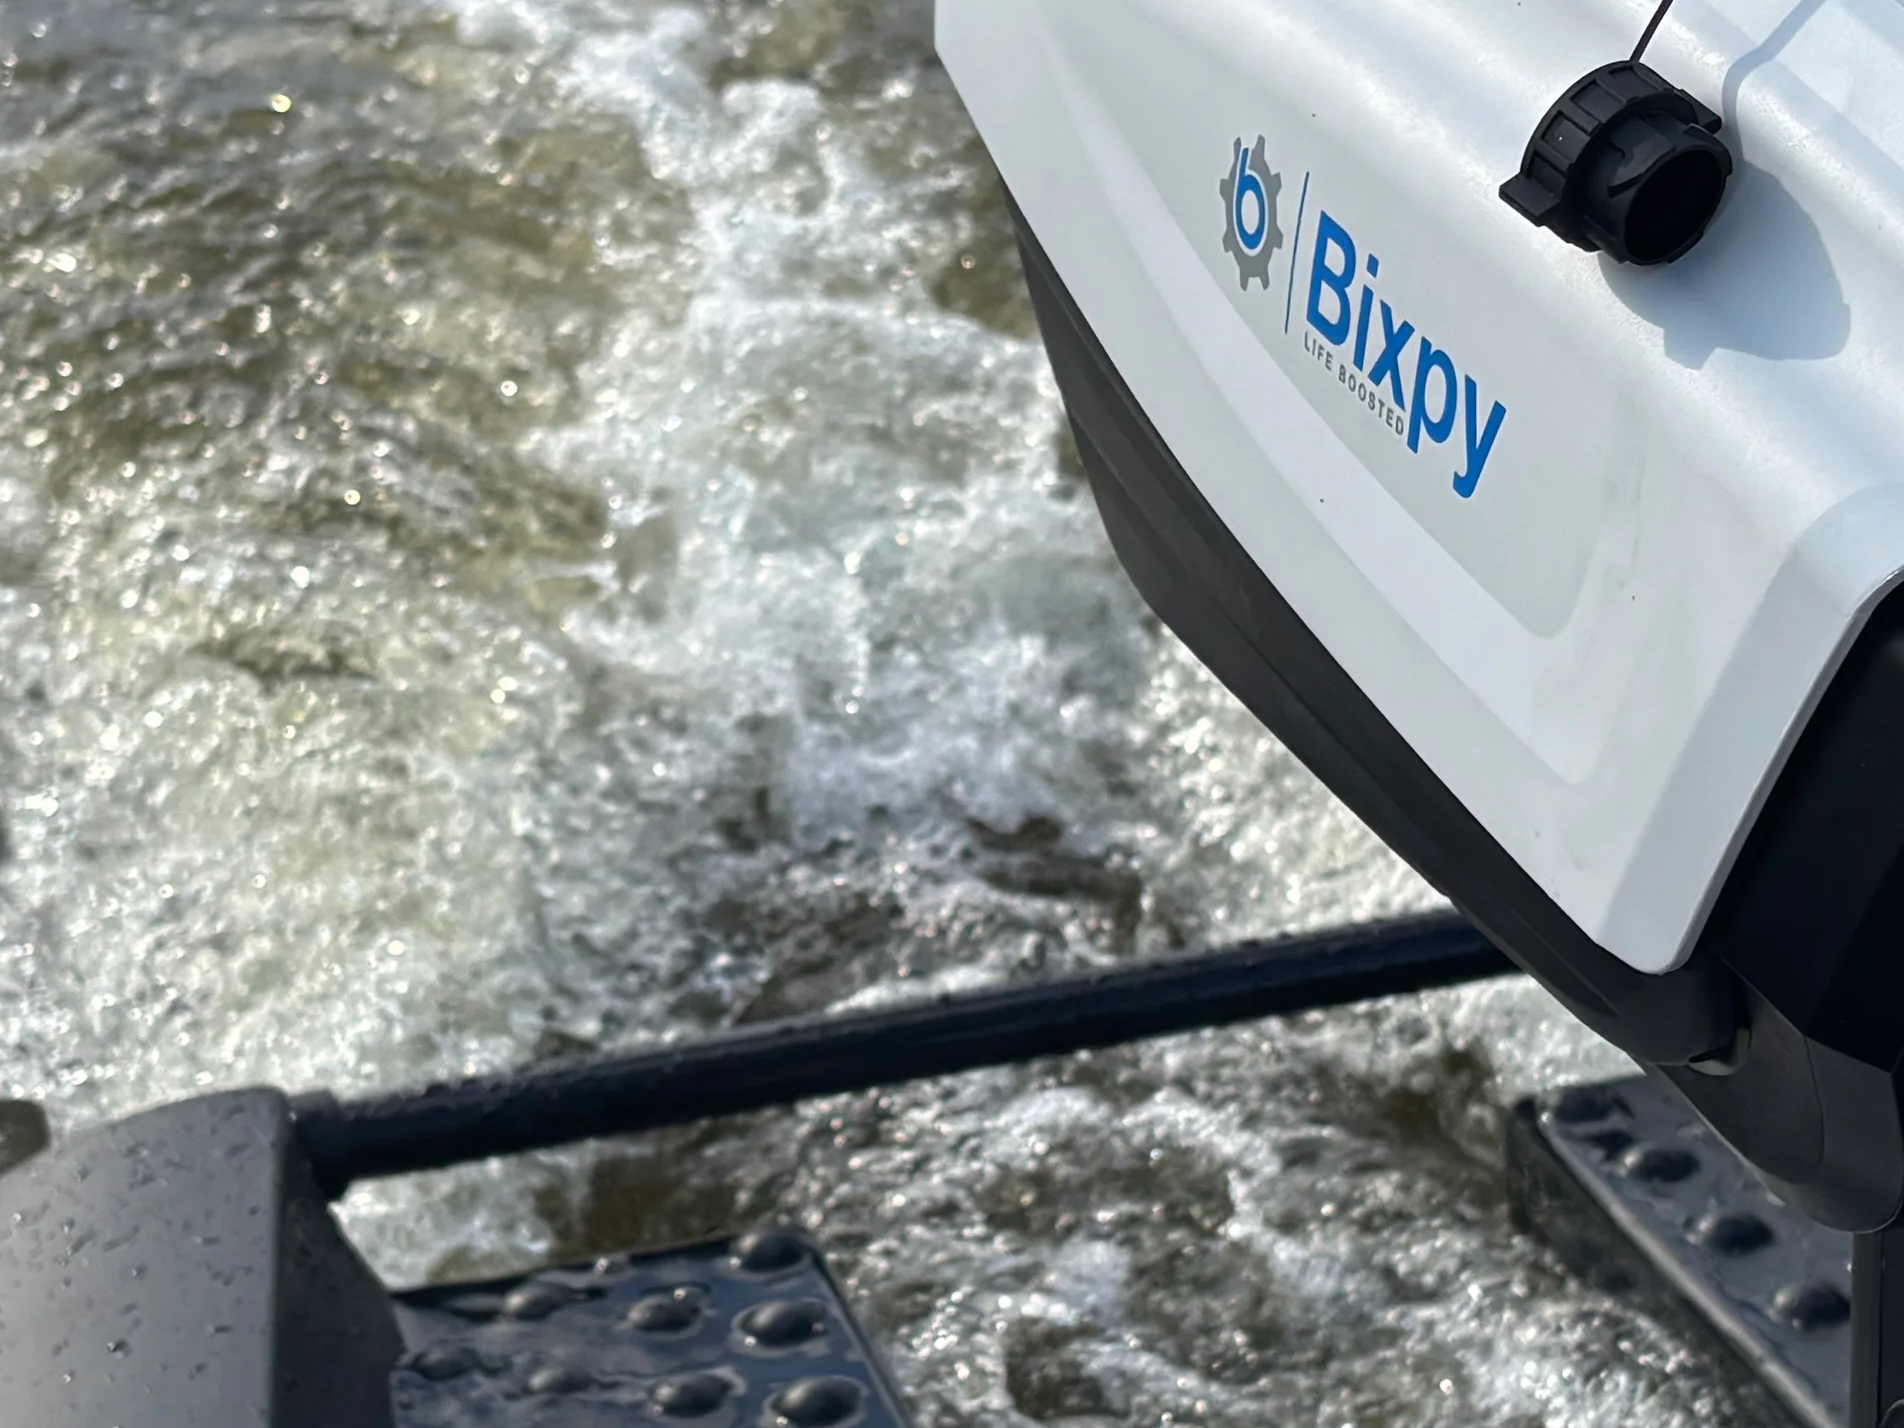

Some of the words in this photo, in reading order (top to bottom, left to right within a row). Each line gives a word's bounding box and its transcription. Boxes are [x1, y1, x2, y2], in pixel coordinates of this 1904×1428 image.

[1303, 331, 1333, 371] LIFE
[1338, 363, 1405, 437] BOOSTED
[1306, 210, 1507, 498] Bixpy
